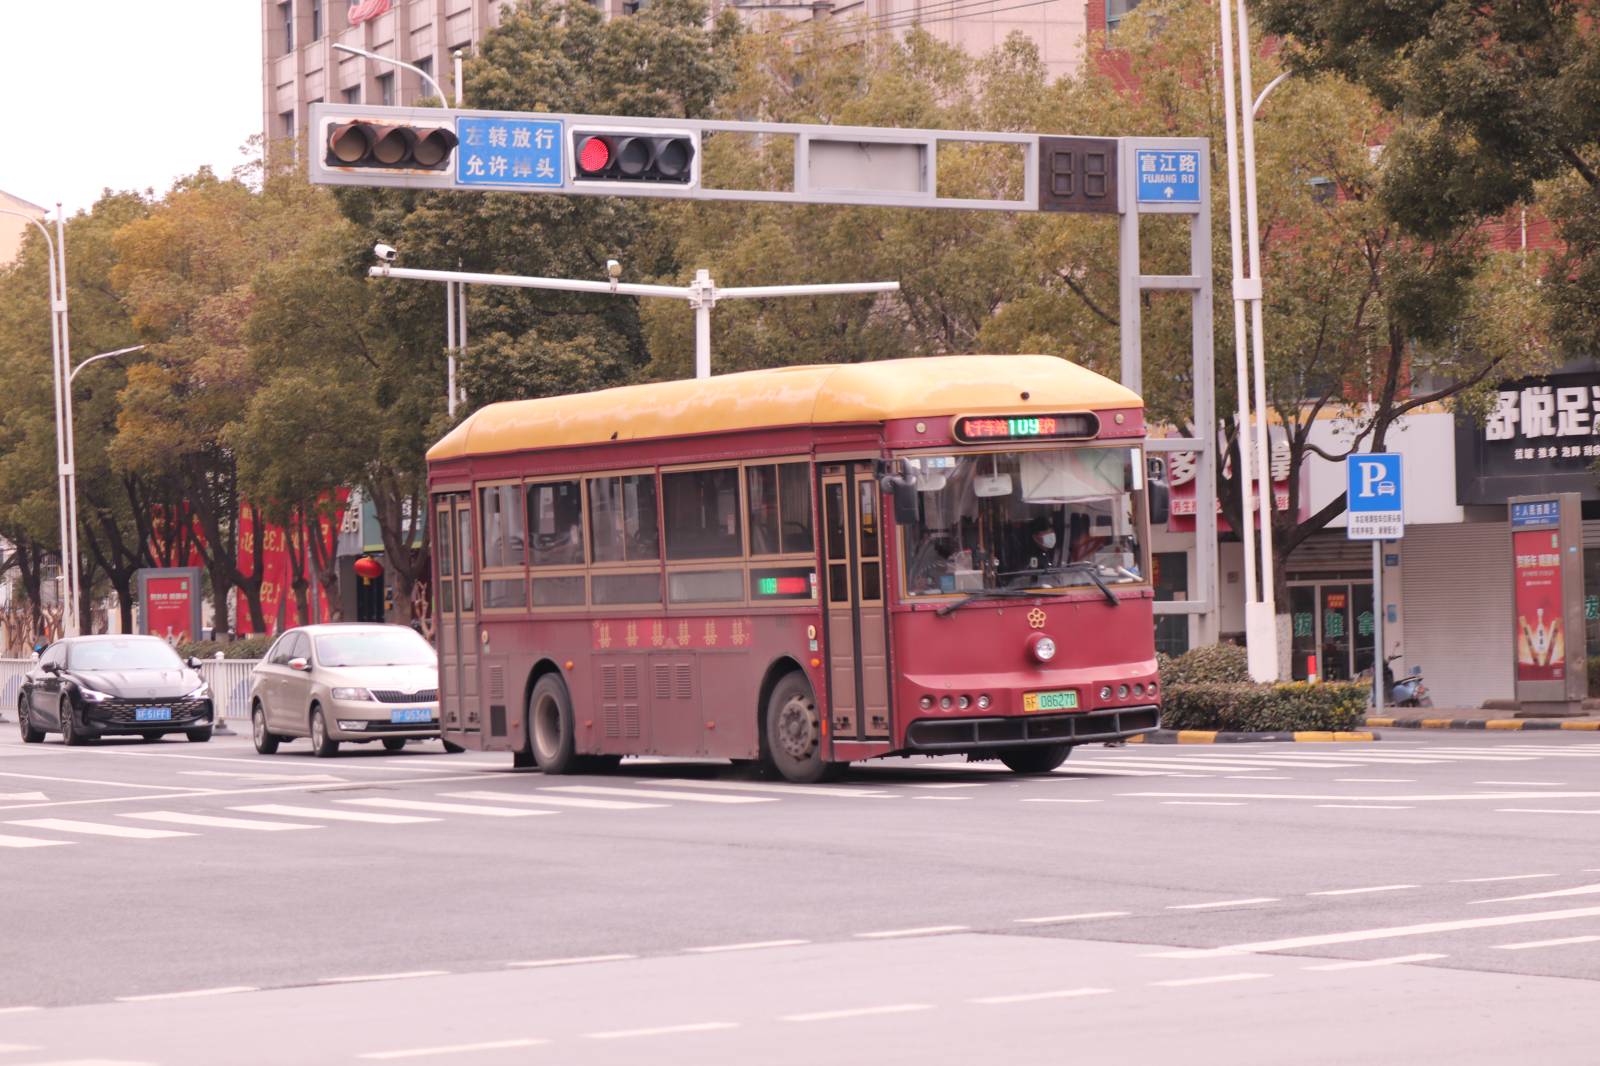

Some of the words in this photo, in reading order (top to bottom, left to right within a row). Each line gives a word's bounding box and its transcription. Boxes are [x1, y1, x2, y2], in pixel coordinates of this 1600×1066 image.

[1140, 154, 1196, 172] 富江路
[1143, 174, 1177, 183] FUJIANG
[1181, 174, 1195, 183] RD
[1486, 386, 1600, 441] 舒悦足
[1358, 462, 1387, 498] P
